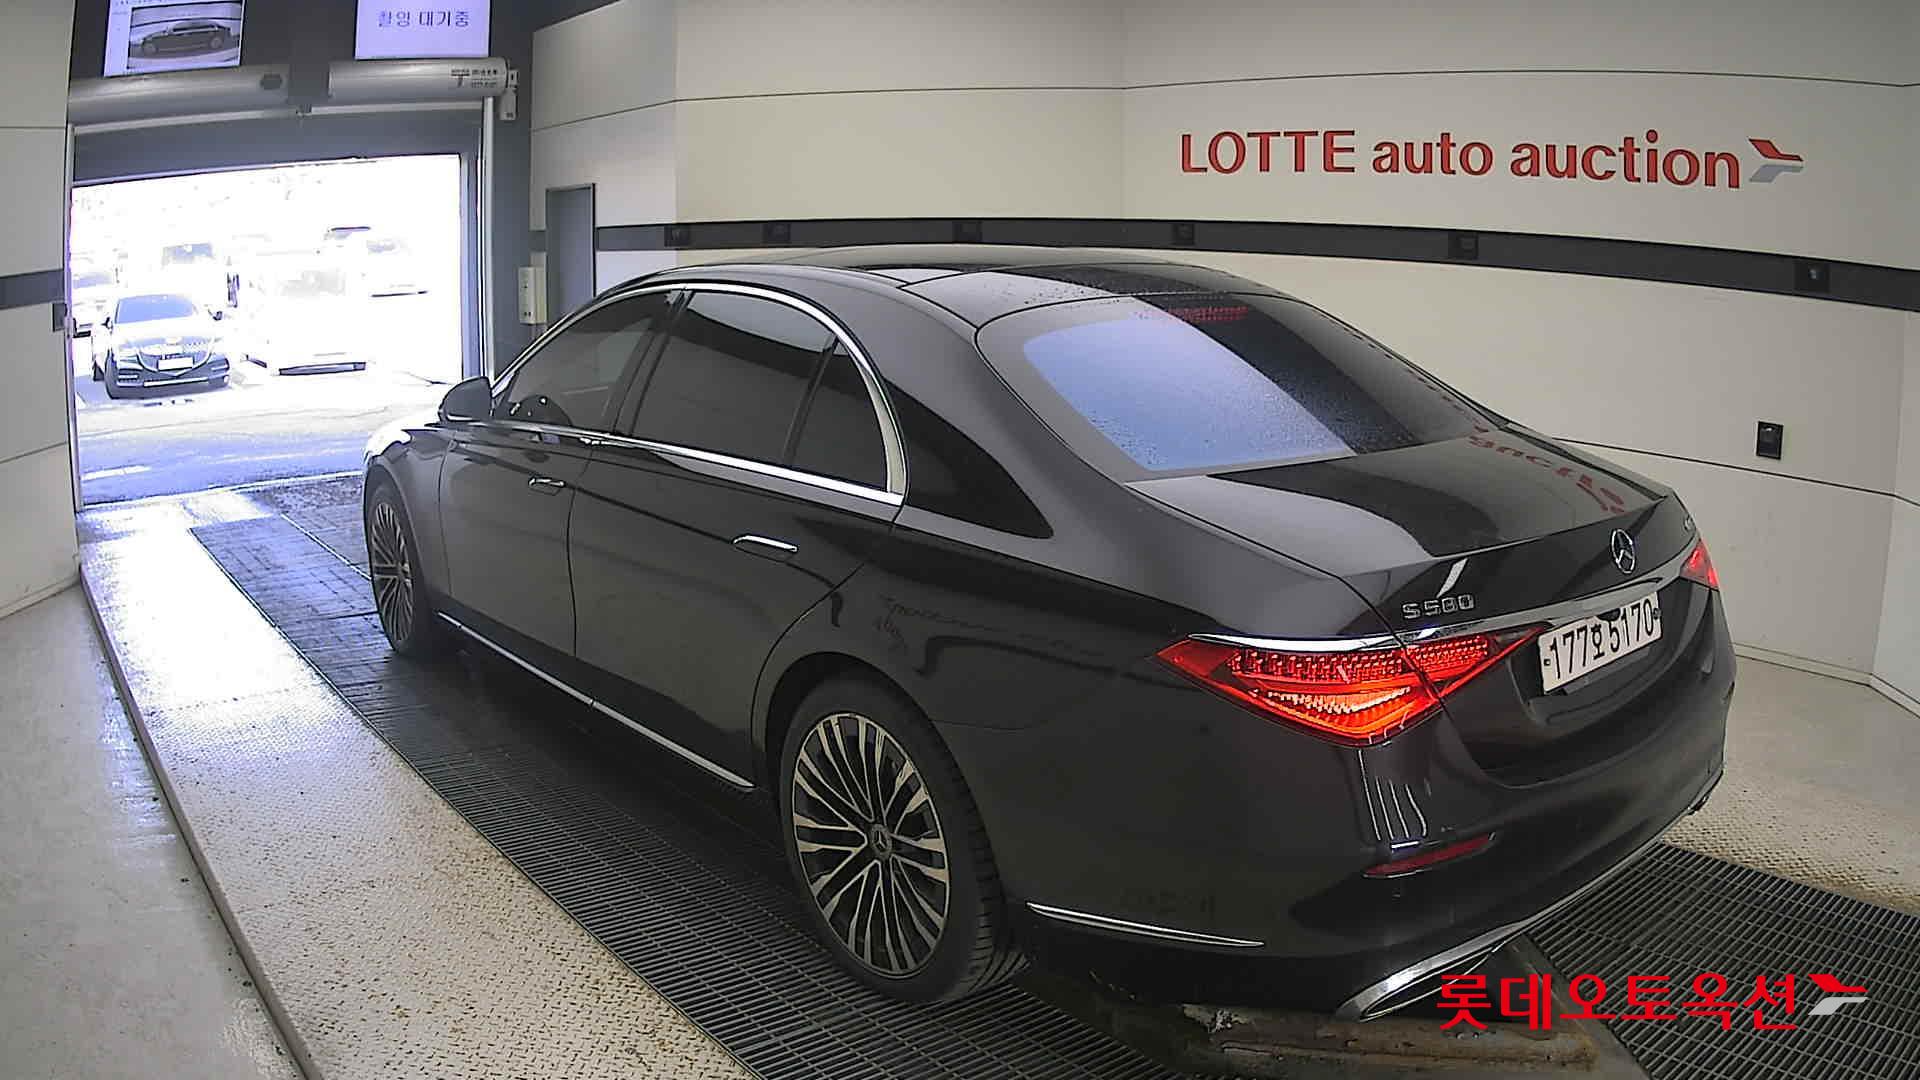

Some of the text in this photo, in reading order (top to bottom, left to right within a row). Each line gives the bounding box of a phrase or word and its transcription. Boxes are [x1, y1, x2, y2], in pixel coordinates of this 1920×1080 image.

[418, 10, 470, 28] 대기중
[1180, 129, 1742, 190] LOTTE auto auction
